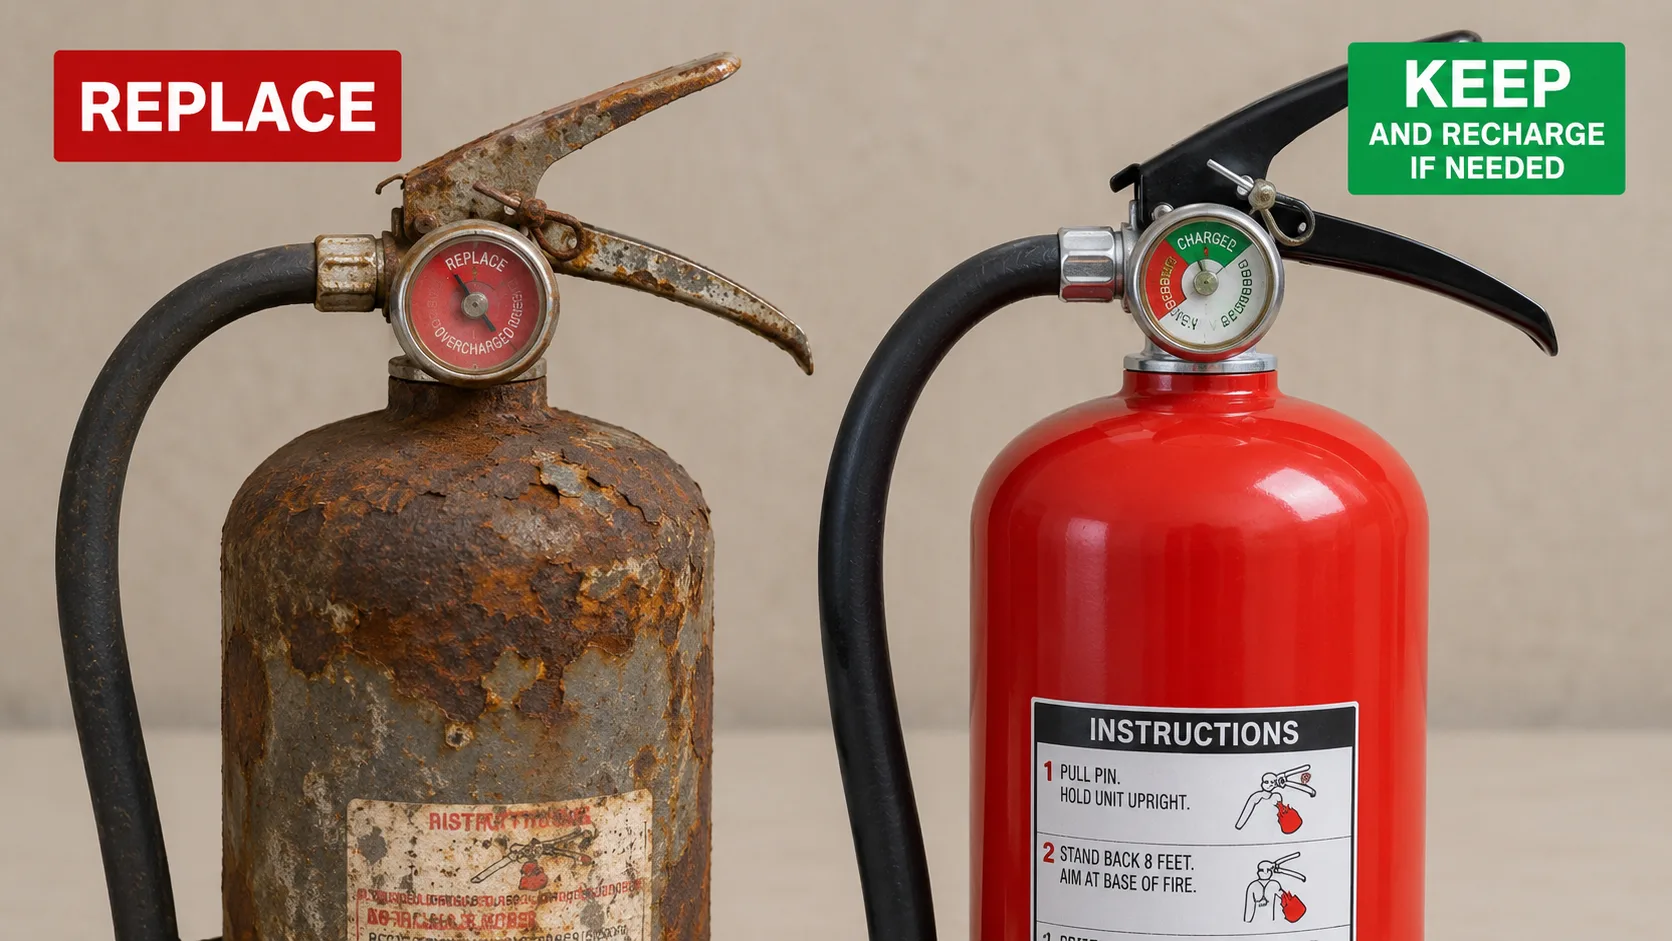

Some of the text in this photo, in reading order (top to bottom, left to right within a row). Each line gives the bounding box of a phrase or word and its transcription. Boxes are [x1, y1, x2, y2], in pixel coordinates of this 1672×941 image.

[445, 251, 508, 273] REPLACE
[434, 326, 515, 355] OVERCHARGED
[1091, 718, 1298, 746] INSTRUCTIONS
[1044, 761, 1120, 784] 1 PULL PIN.
[1061, 788, 1189, 810] HOLD UNIT UPRIGHT.
[1043, 842, 1193, 870] 2 STAND BACK 8 FEET.
[1060, 869, 1196, 892] AIM AT BASE OF FIRE.
